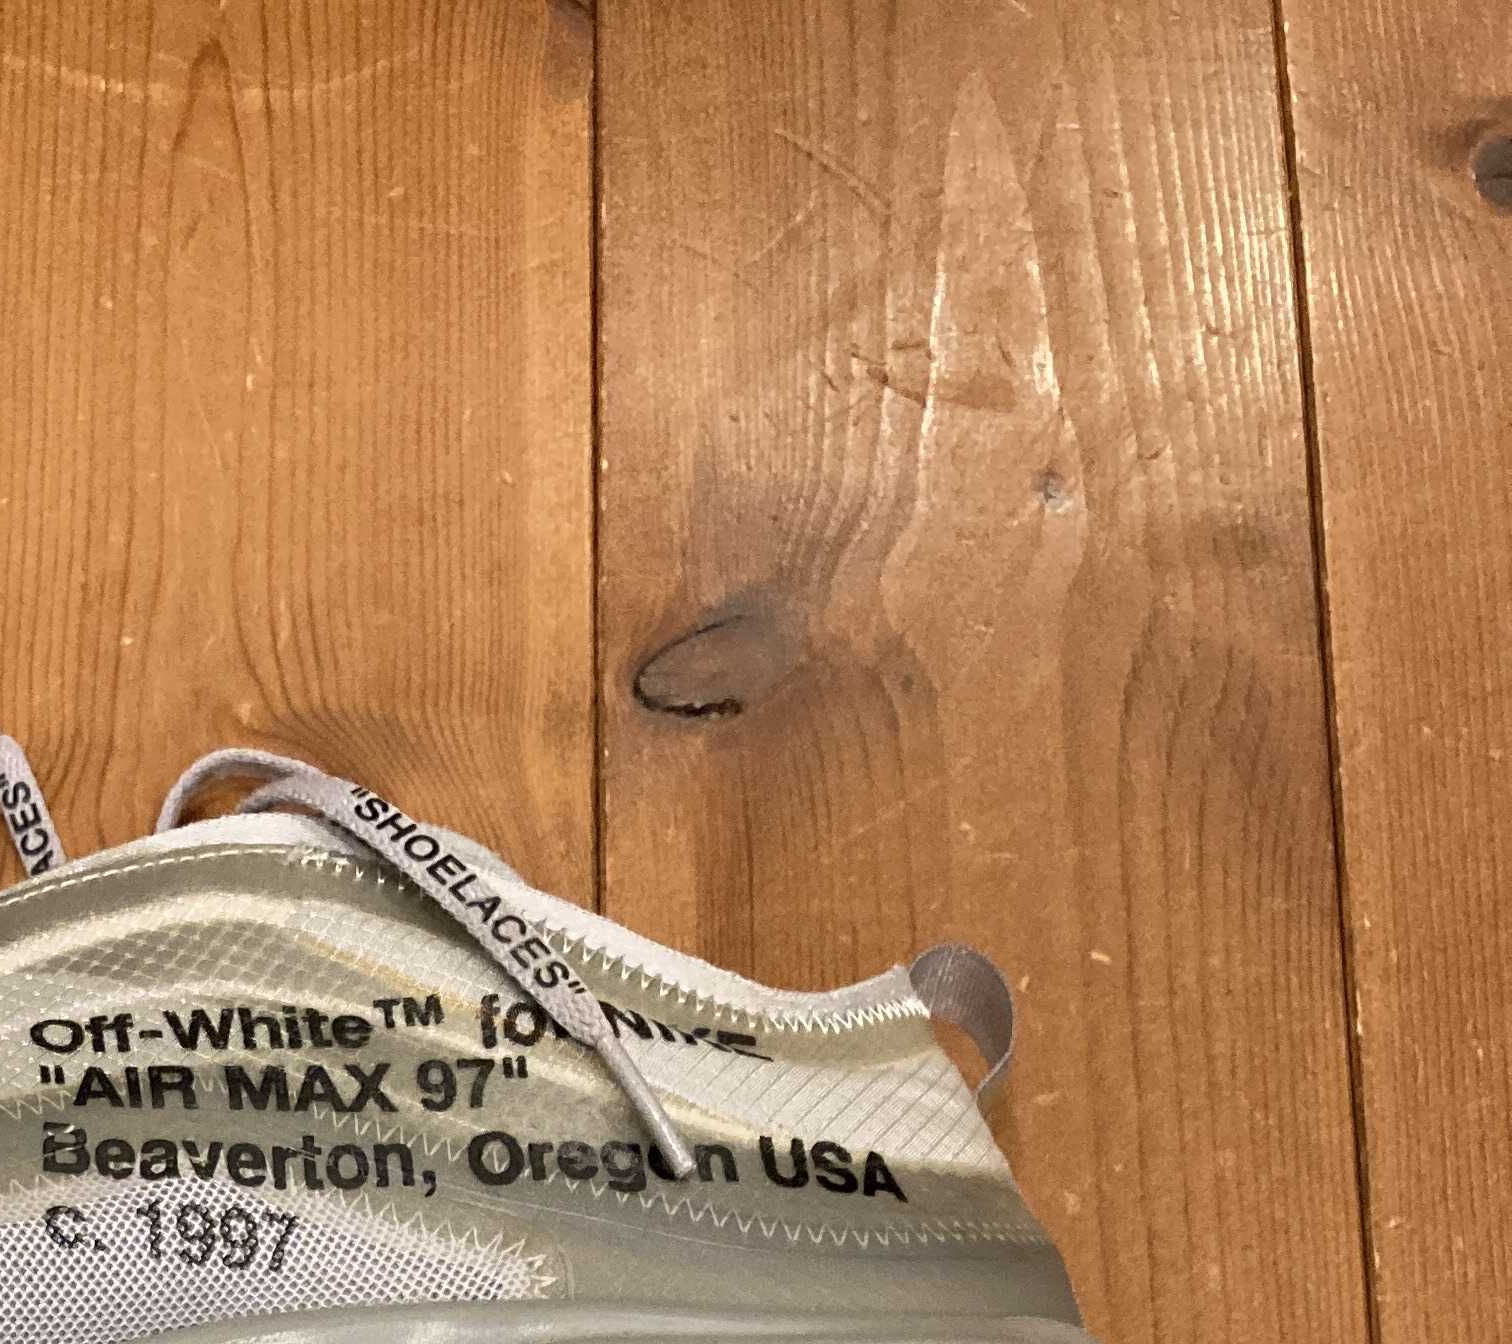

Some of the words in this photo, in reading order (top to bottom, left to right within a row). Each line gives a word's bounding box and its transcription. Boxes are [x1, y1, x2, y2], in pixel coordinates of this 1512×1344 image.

[351, 786, 587, 995] "SHOELACES"
[481, 994, 573, 1049] fo
[39, 1064, 198, 1109] "AIR
[224, 1062, 399, 1112] MAX
[416, 1056, 529, 1112] 97"
[41, 1120, 438, 1198] Beaverton,
[758, 1135, 909, 1203] USA
[45, 1204, 107, 1253] c.
[136, 1200, 298, 1272] 1997
